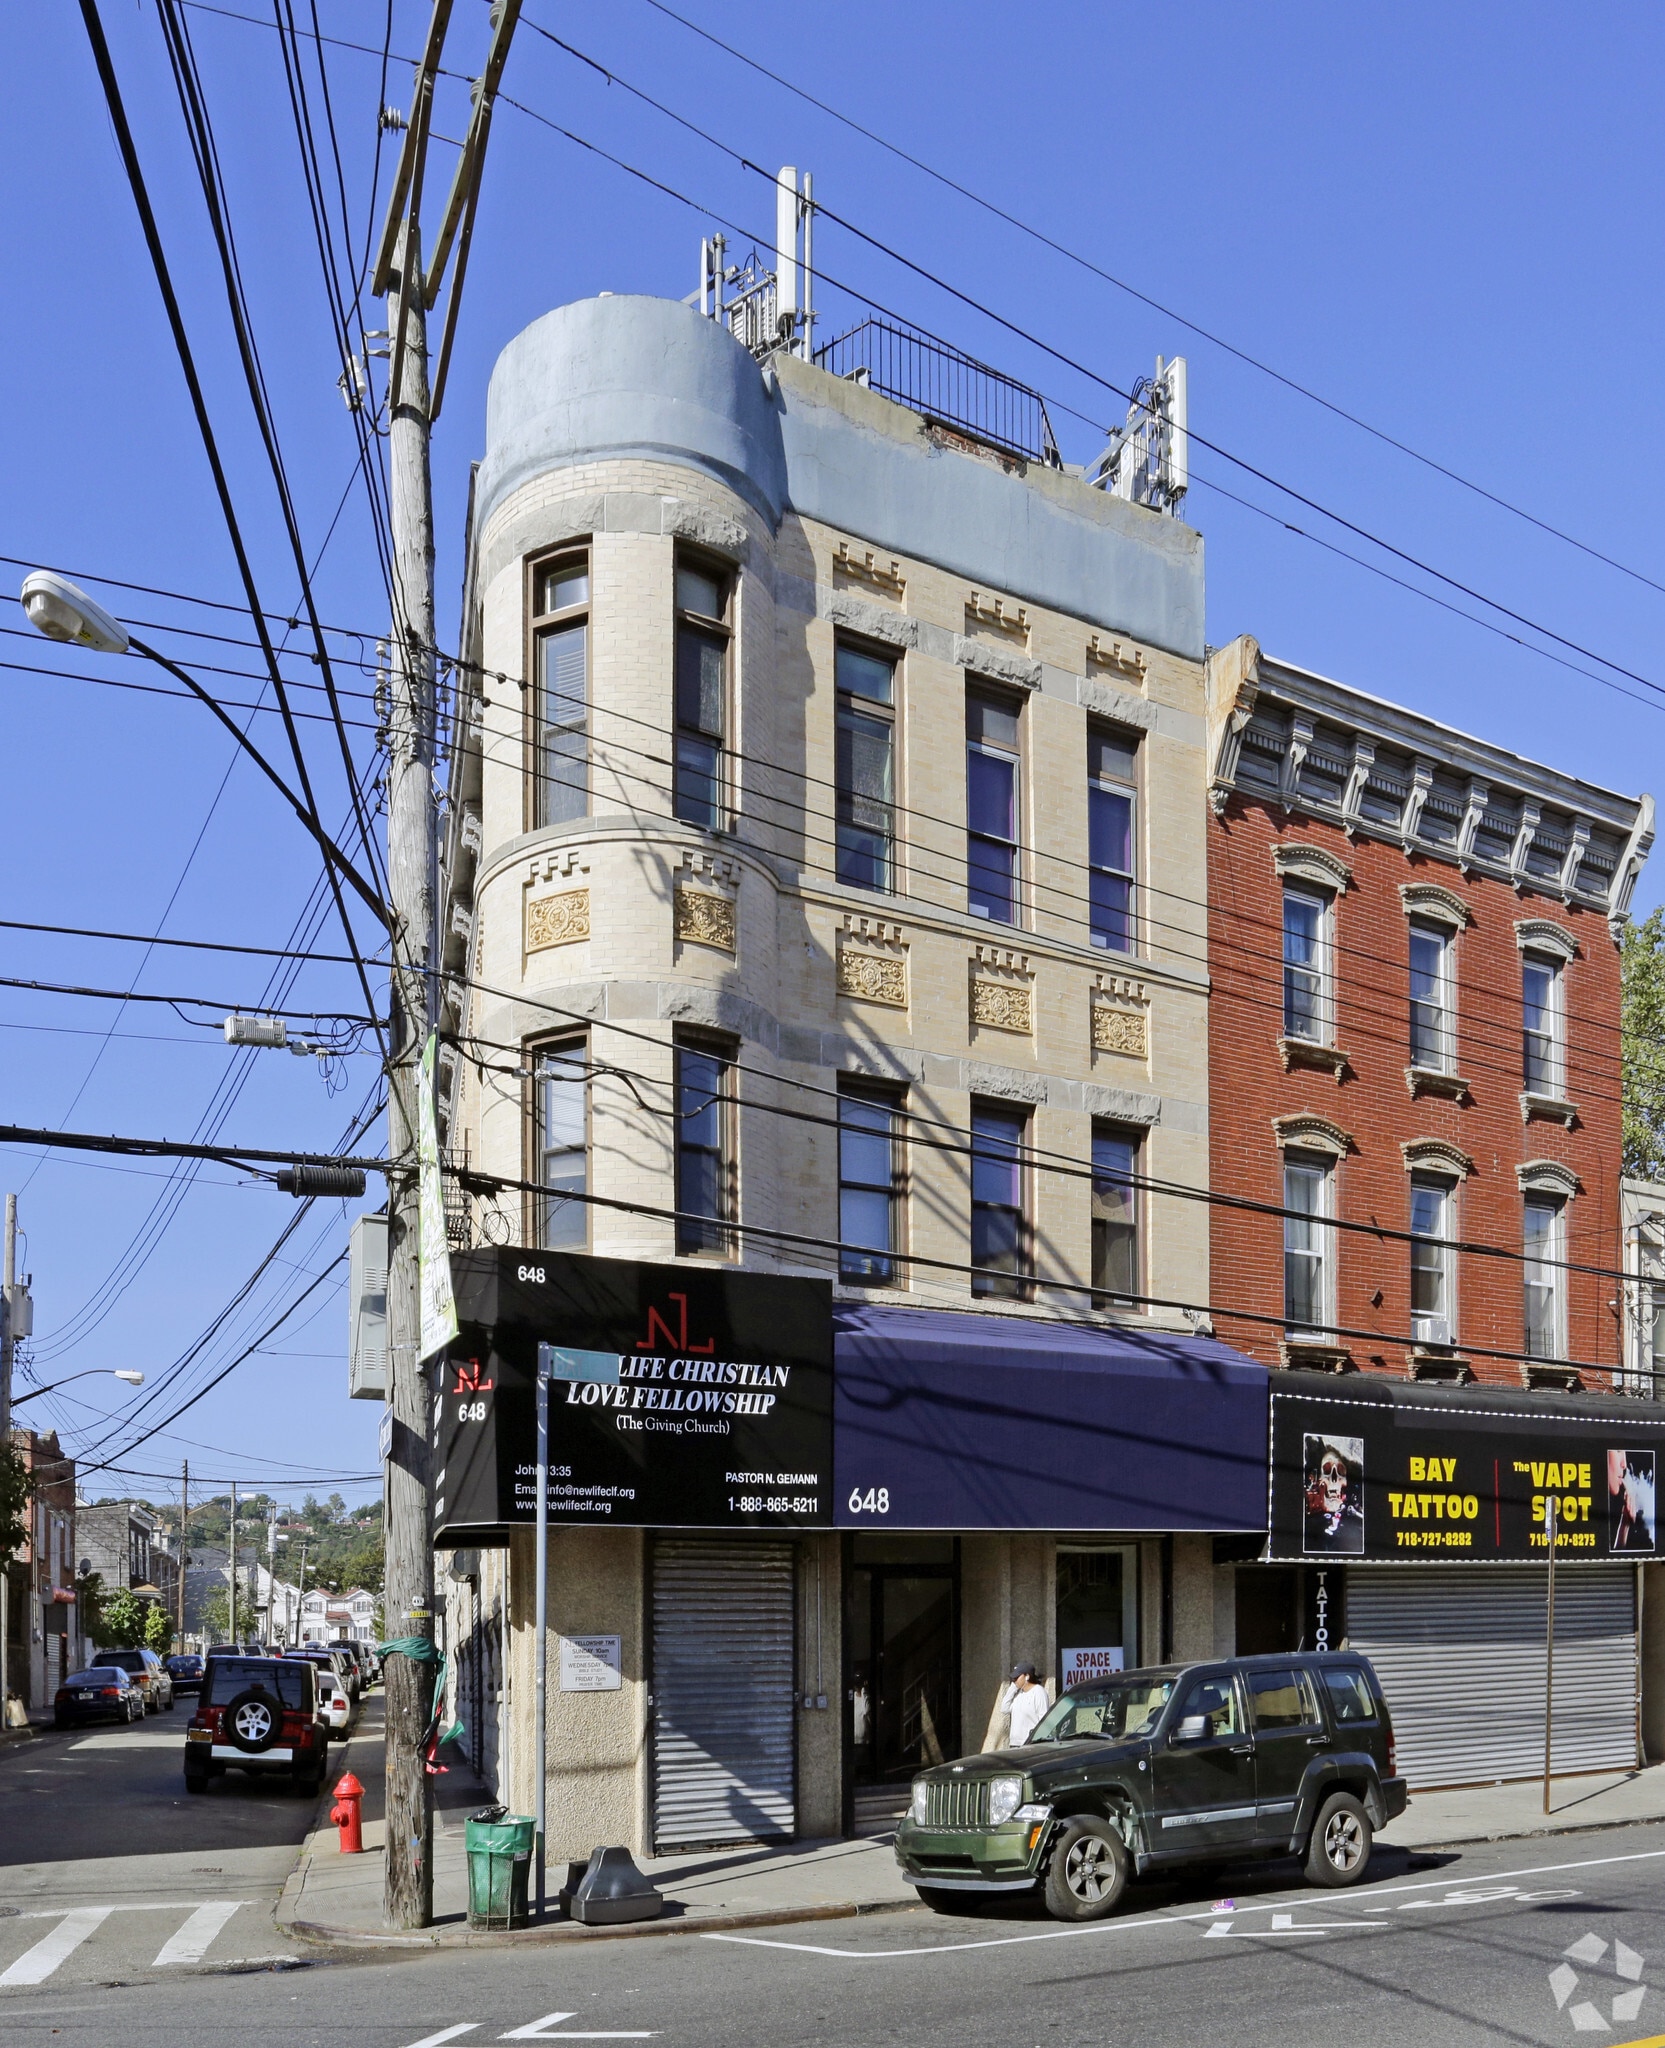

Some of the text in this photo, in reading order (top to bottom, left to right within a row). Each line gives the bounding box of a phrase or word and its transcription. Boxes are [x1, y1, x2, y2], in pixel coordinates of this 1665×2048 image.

[517, 1265, 546, 1283] 648
[618, 1356, 665, 1380] LIFE
[668, 1359, 790, 1387] CHRISTIAN
[566, 1381, 776, 1415] LOVE FELLOWSHIP
[458, 1402, 486, 1422] 648
[616, 1415, 730, 1435] (The Giving Church)
[515, 1464, 537, 1475] Joh
[725, 1472, 818, 1486] PASTOR N. GEMANN
[1409, 1456, 1457, 1482] BAY
[1513, 1461, 1592, 1488] The VAPE
[547, 1485, 635, 1500] info@newlifeclf.org
[848, 1487, 890, 1514] 648
[728, 1496, 818, 1513] 1-888-865-5211
[1388, 1493, 1479, 1519] TATTOO
[1397, 1532, 1472, 1547] 718-727-8282
[1530, 1533, 1596, 1547] 718-47-8273
[1316, 1572, 1328, 1652] TATTOO
[1075, 1652, 1110, 1668] SPACE
